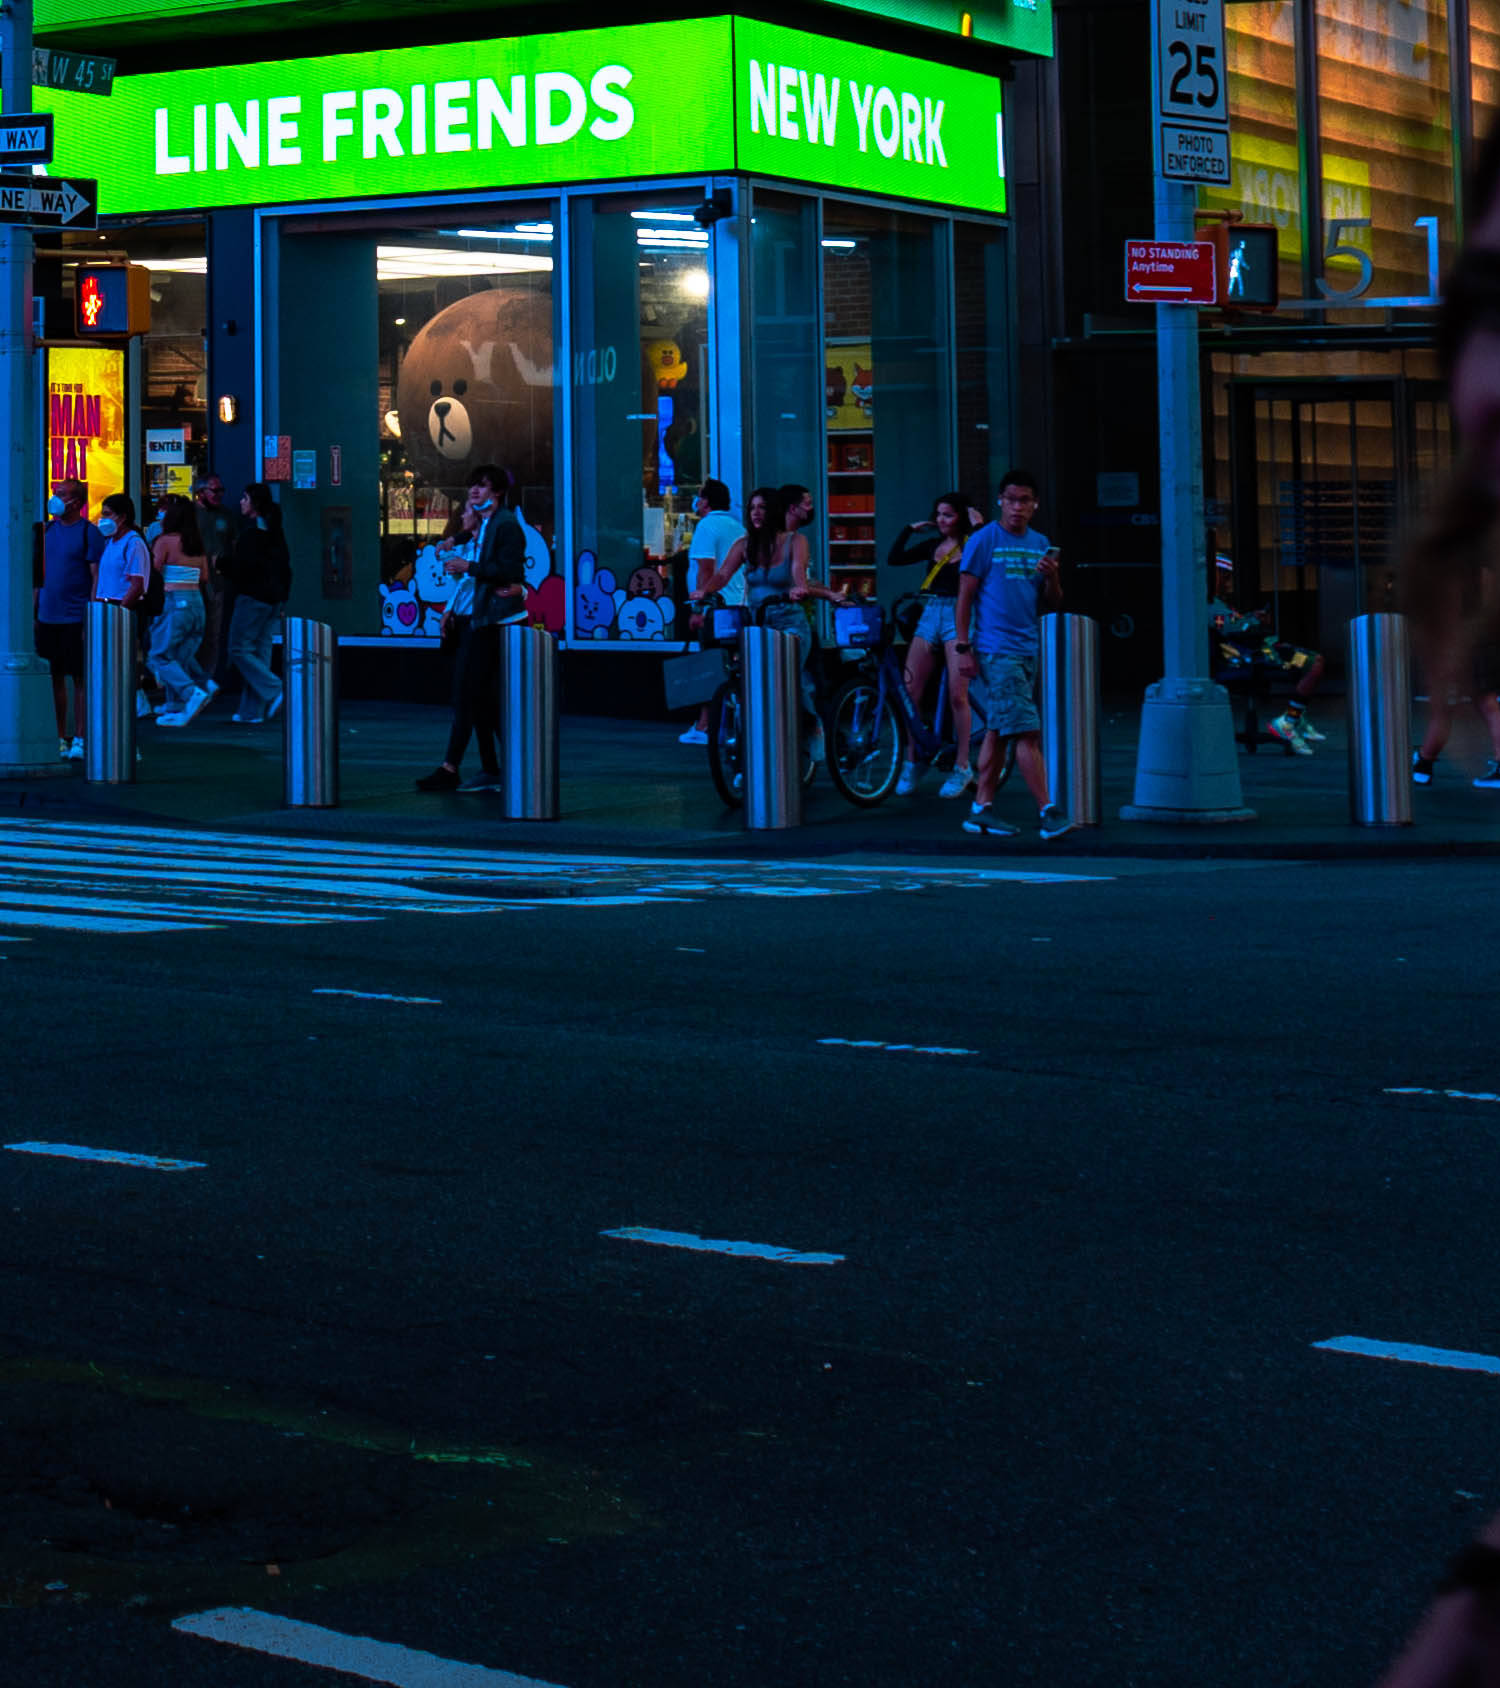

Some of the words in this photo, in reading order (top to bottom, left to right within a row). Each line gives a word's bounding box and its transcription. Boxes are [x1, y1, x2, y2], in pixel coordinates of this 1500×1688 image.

[1175, 10, 1207, 34] LIMIT
[52, 56, 69, 84] W
[75, 60, 95, 88] 45
[101, 63, 113, 81] St
[1169, 40, 1219, 109] 25
[155, 95, 303, 175] LINE
[323, 64, 635, 161] FRIENDS
[749, 60, 840, 146] NEW
[850, 81, 949, 169] YORK
[6, 129, 38, 150] WAY
[1178, 134, 1214, 154] PHOTO
[1168, 153, 1225, 176] ENFORCED
[40, 192, 78, 213] WAY
[1131, 246, 1146, 260] NO
[1148, 247, 1200, 260] STANDING
[1132, 261, 1174, 274] Anytime
[51, 394, 101, 437] MAN
[51, 438, 88, 481] HAT
